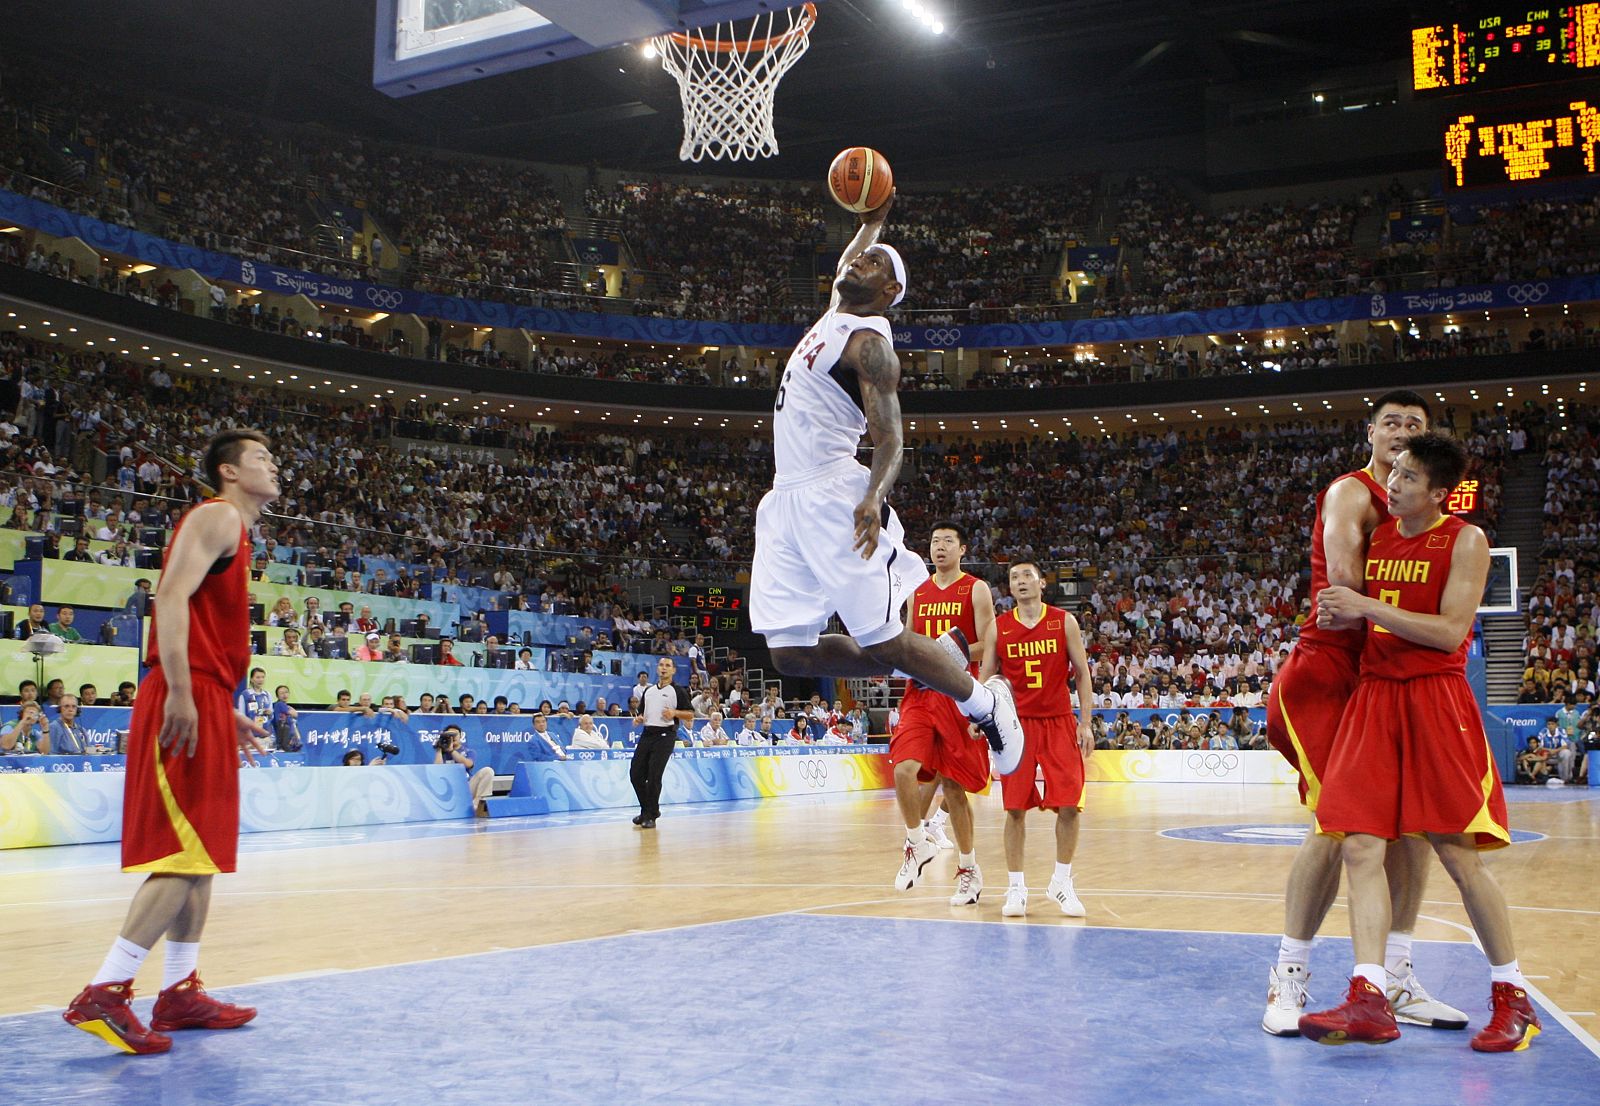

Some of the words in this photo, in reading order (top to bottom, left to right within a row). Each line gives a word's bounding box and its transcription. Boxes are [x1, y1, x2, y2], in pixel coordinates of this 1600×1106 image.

[1479, 16, 1501, 29] USA
[1527, 9, 1549, 22] CHN
[1505, 24, 1532, 38] 5:52
[1484, 46, 1500, 58] 53
[1512, 42, 1521, 53] 3
[1536, 38, 1551, 51] 39
[1547, 52, 1556, 63] 2
[1478, 62, 1486, 73] 2
[1498, 123, 1522, 133] FIELD
[1526, 120, 1552, 129] GOALS
[1513, 128, 1542, 138] POINTS
[1499, 144, 1518, 154] FREE
[1523, 140, 1553, 150] THROWS
[1513, 135, 1543, 145] POINTS
[1504, 149, 1543, 160] REBOUNDS
[1509, 156, 1544, 166] ASSISTS
[1505, 162, 1549, 174] TURNOVERS
[1509, 170, 1540, 181] STEALS
[270, 271, 319, 297] Beijing
[320, 282, 354, 299] 2008
[1403, 293, 1454, 311] Beijing
[1457, 290, 1493, 304] 2008
[1448, 494, 1474, 511] 20
[1365, 559, 1430, 584] CHINA
[671, 585, 685, 593] USA
[673, 595, 682, 607] 2
[731, 599, 741, 609] 2
[918, 602, 962, 617] CHINA
[703, 615, 711, 627] 3
[721, 617, 737, 629] 39
[1006, 638, 1057, 658] CHINA
[1025, 660, 1043, 689] 5
[1506, 717, 1537, 727] Dream
[486, 732, 500, 743] One
[502, 731, 522, 743] World
